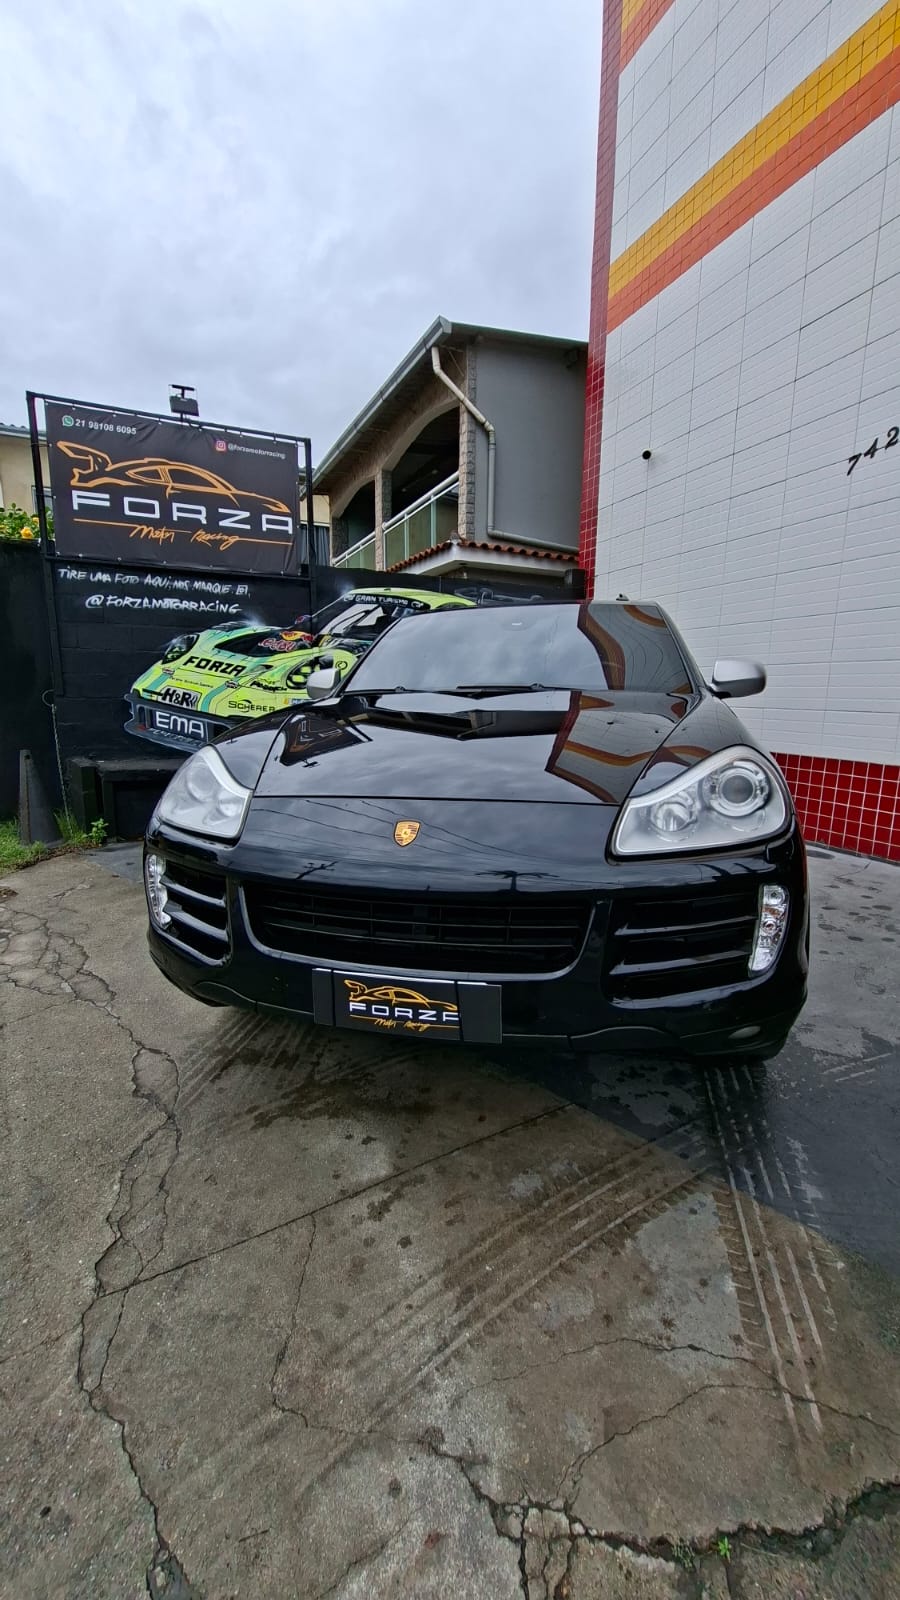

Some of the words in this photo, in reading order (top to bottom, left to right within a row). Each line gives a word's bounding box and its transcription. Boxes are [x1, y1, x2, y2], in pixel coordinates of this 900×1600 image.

[75, 418, 86, 428] 21
[88, 420, 115, 432] 98108
[116, 424, 138, 435] 6095
[847, 426, 900, 476] 742
[71, 489, 294, 535] FORZA
[190, 530, 241, 551] Racing
[114, 573, 140, 585] FOTO
[183, 656, 248, 677] FORZA
[162, 687, 193, 707] H&R
[155, 711, 205, 739] EMA
